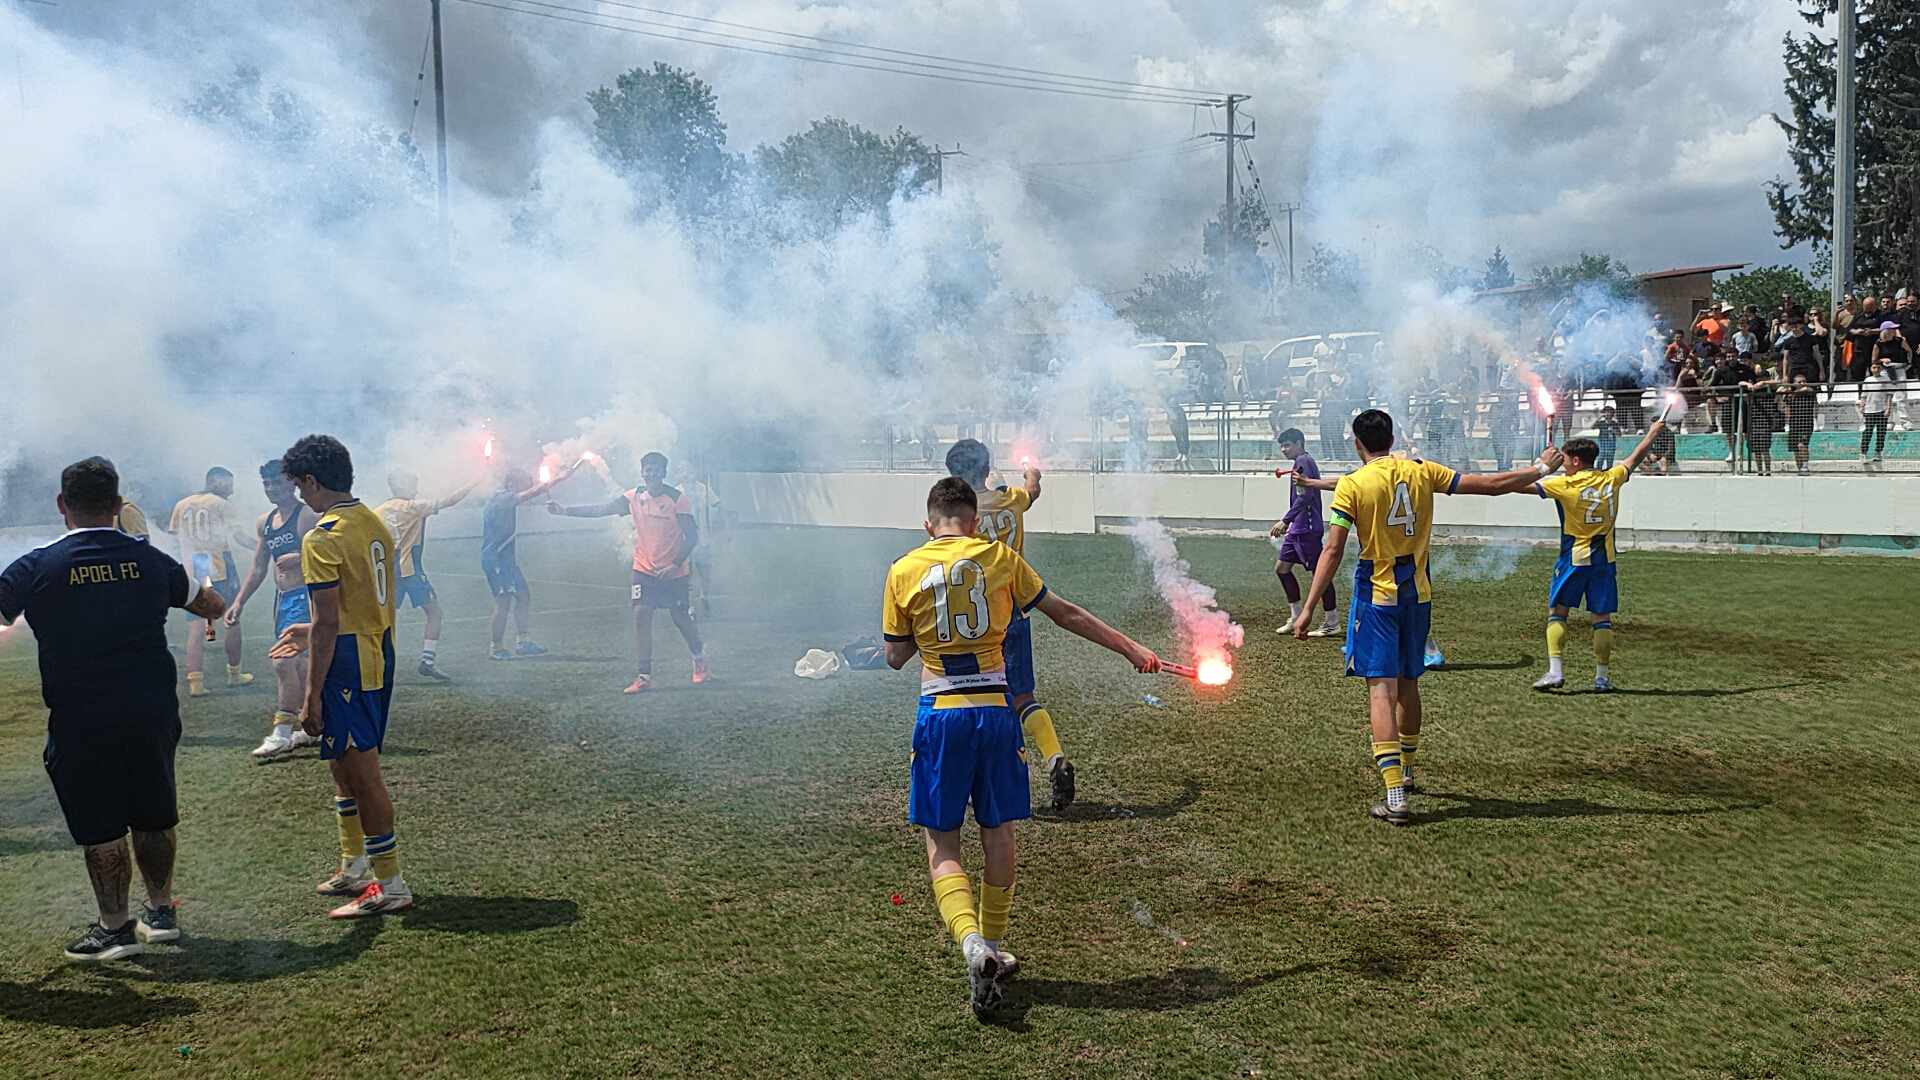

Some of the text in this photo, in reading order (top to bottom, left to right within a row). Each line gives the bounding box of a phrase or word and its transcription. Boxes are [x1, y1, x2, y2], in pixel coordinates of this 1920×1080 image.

[1387, 481, 1416, 536] 4
[1581, 483, 1615, 524] 21
[69, 562, 140, 585] APOEL FC
[370, 540, 387, 606] 6
[921, 559, 990, 642] 13
